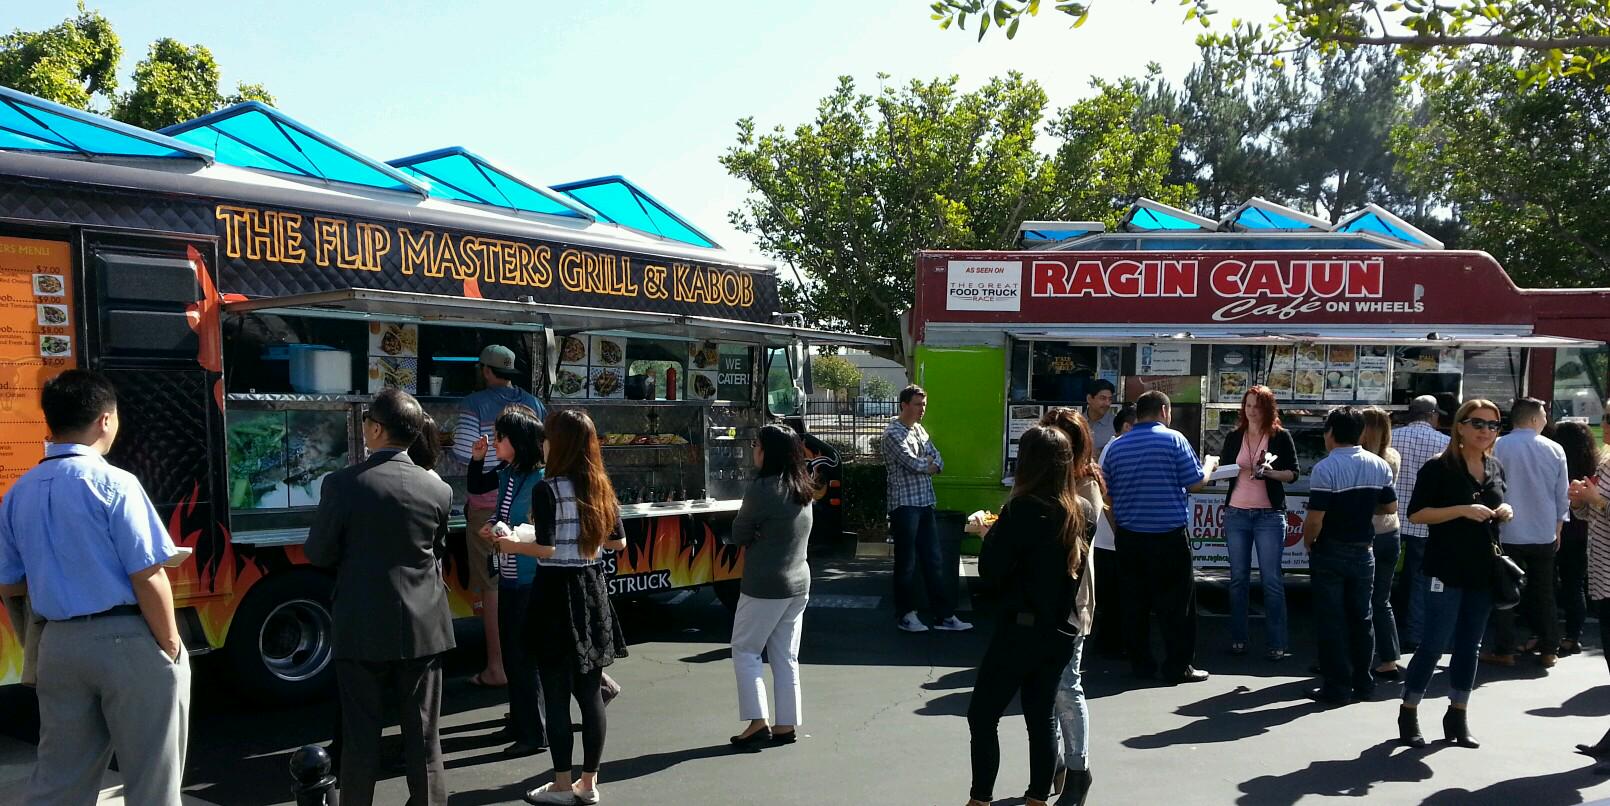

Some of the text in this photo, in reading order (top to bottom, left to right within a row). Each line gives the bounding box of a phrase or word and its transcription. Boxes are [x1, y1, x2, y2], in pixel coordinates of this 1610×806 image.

[18, 246, 50, 257] MENU
[216, 204, 754, 307] THE FLIP MASTERS GRILL & KABOB
[36, 265, 61, 274] $7.00
[1031, 259, 1385, 298] RAGIN CAJUN
[950, 288, 1017, 296] FOOD TRUCK
[1211, 296, 1424, 321] Café ON WHEELS
[717, 357, 750, 385] WE CATER!
[608, 573, 668, 595] STRUCK
